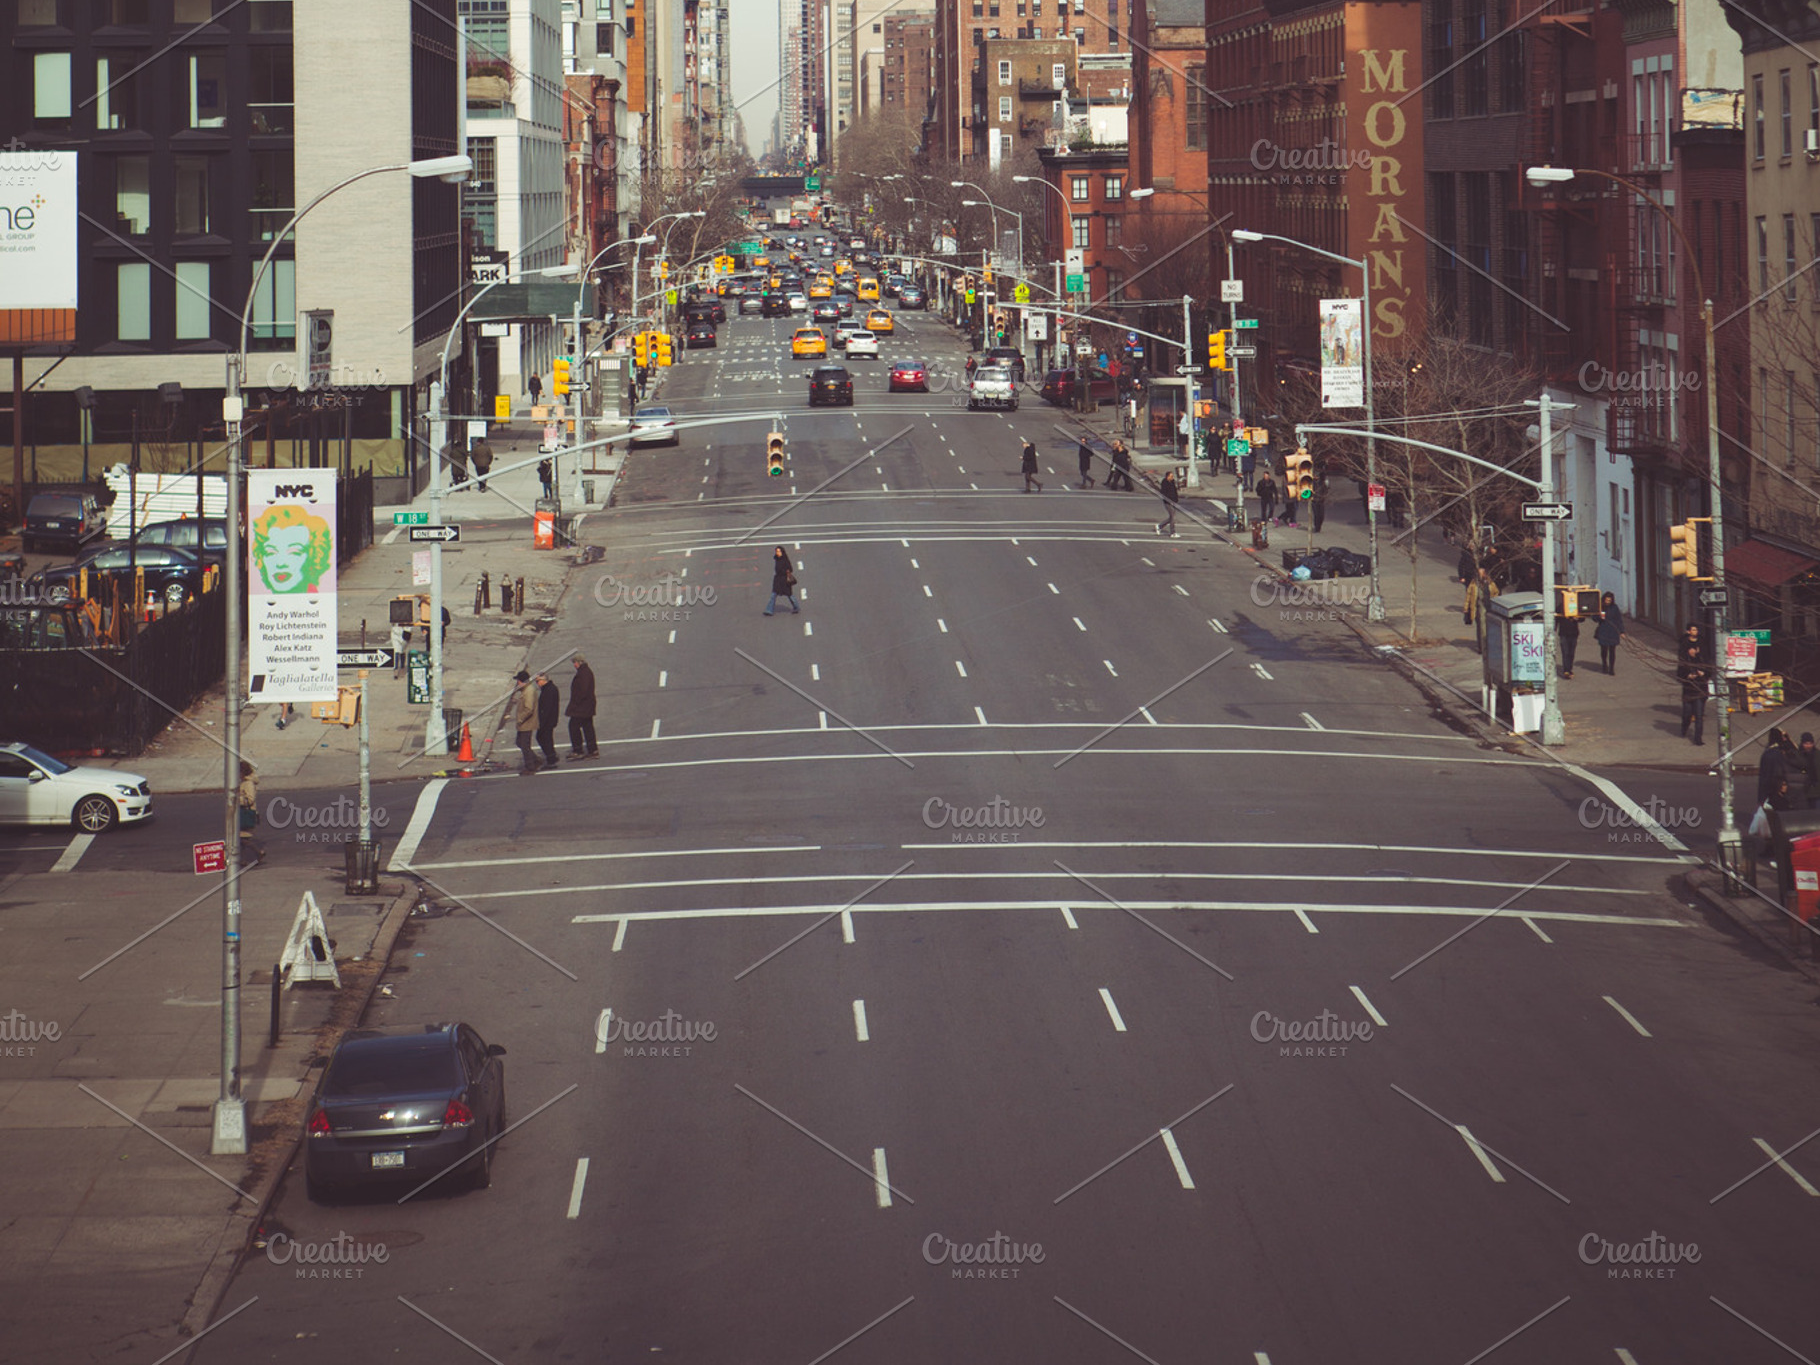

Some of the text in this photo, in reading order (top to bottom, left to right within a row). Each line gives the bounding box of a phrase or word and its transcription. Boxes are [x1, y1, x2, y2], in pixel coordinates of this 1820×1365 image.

[1358, 49, 1412, 339] MORAN'S
[6, 233, 35, 241] GROUP
[275, 484, 313, 498] NYC
[396, 514, 404, 523] W
[408, 513, 418, 524] 18
[266, 610, 320, 620] Andy Warhol
[259, 622, 327, 631] Roy Lichtenstein
[262, 632, 324, 641] Robert Indiana
[1513, 634, 1534, 646] SKI
[274, 643, 312, 652] Alex Katz
[1522, 646, 1543, 657] SKI
[266, 655, 320, 664] Wessellmann
[341, 654, 386, 663] ONE WAY
[298, 682, 335, 692] Galleries
